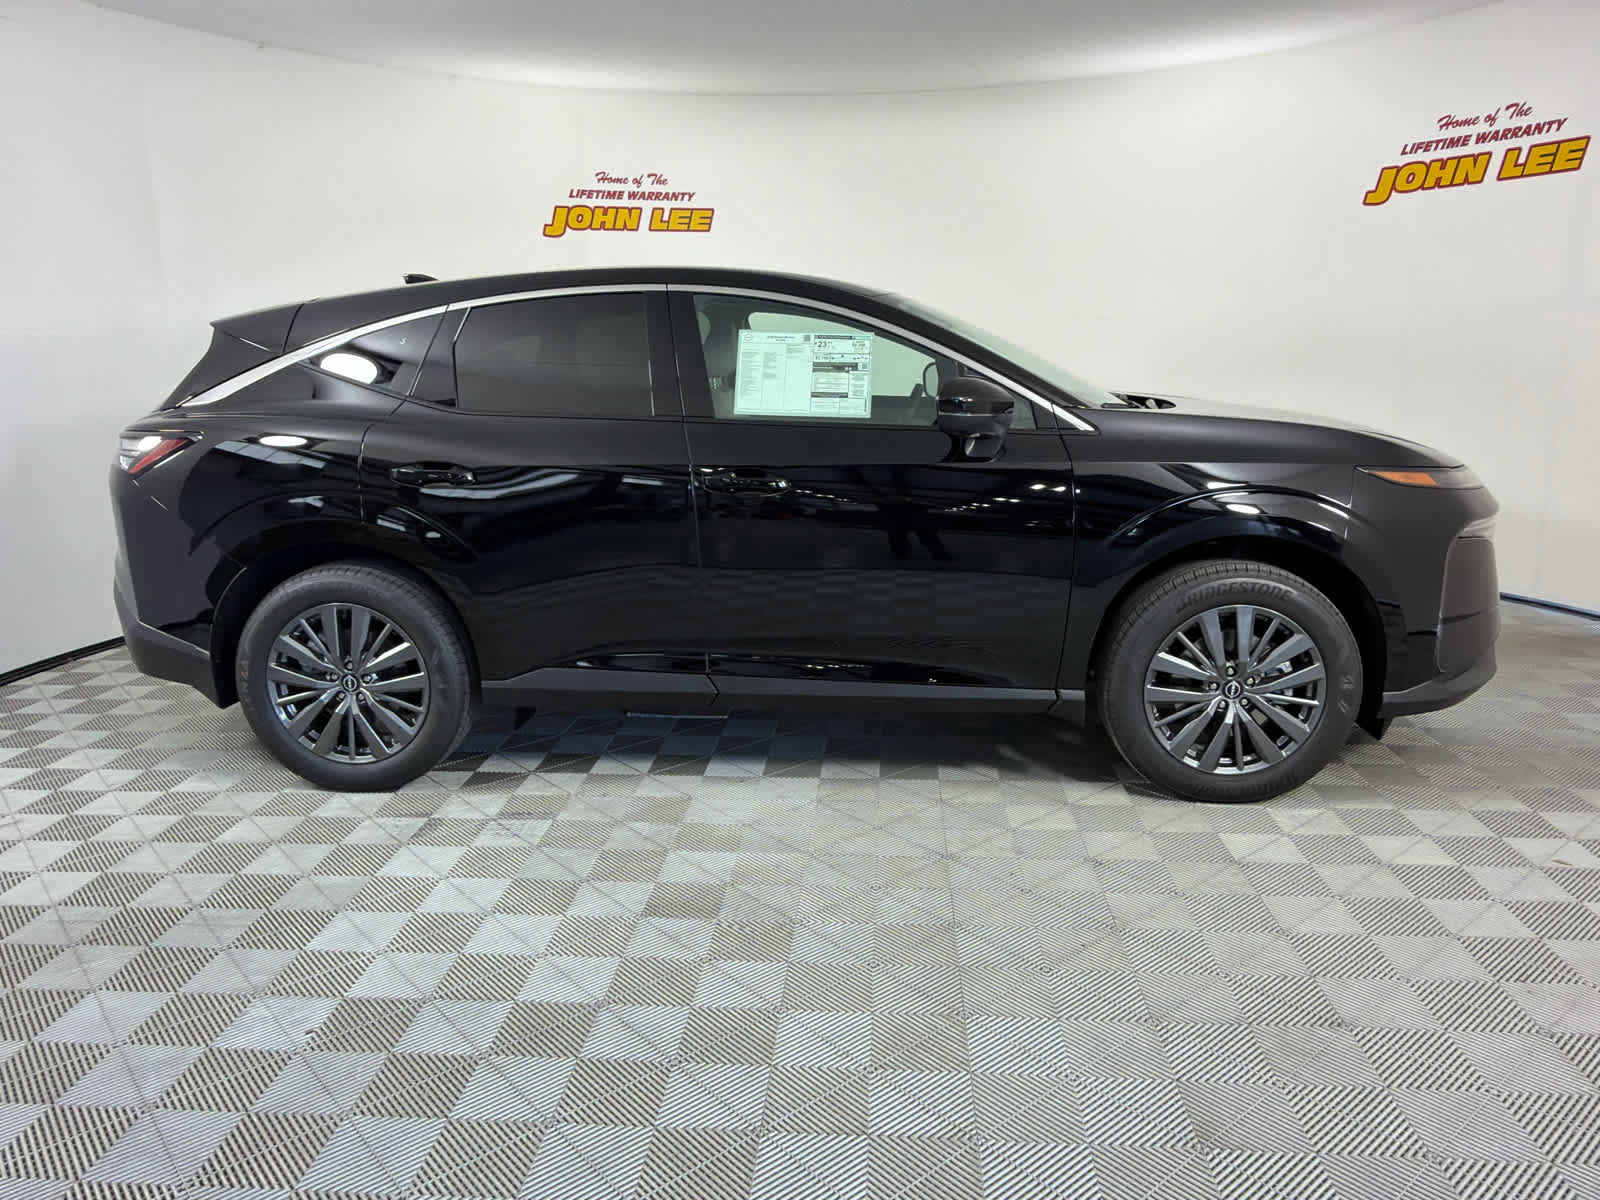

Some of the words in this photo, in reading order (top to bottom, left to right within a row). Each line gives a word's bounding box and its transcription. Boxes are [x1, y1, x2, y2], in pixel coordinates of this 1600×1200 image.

[1436, 114, 1480, 132] Home
[1484, 107, 1501, 127] of
[1505, 101, 1533, 120] The
[1400, 134, 1472, 156] LIFETIME
[1475, 117, 1568, 145] WARRANTY
[594, 171, 629, 185] Home
[631, 174, 644, 188] of
[646, 173, 668, 186] The
[1362, 151, 1493, 206] JOHN
[1496, 135, 1592, 181] LEE
[568, 189, 625, 200] LIFETIME
[627, 191, 696, 202] WARRANTY
[542, 205, 643, 238] JOHN
[648, 207, 715, 233] LEE
[1176, 581, 1292, 612] BRIDGESTONE
